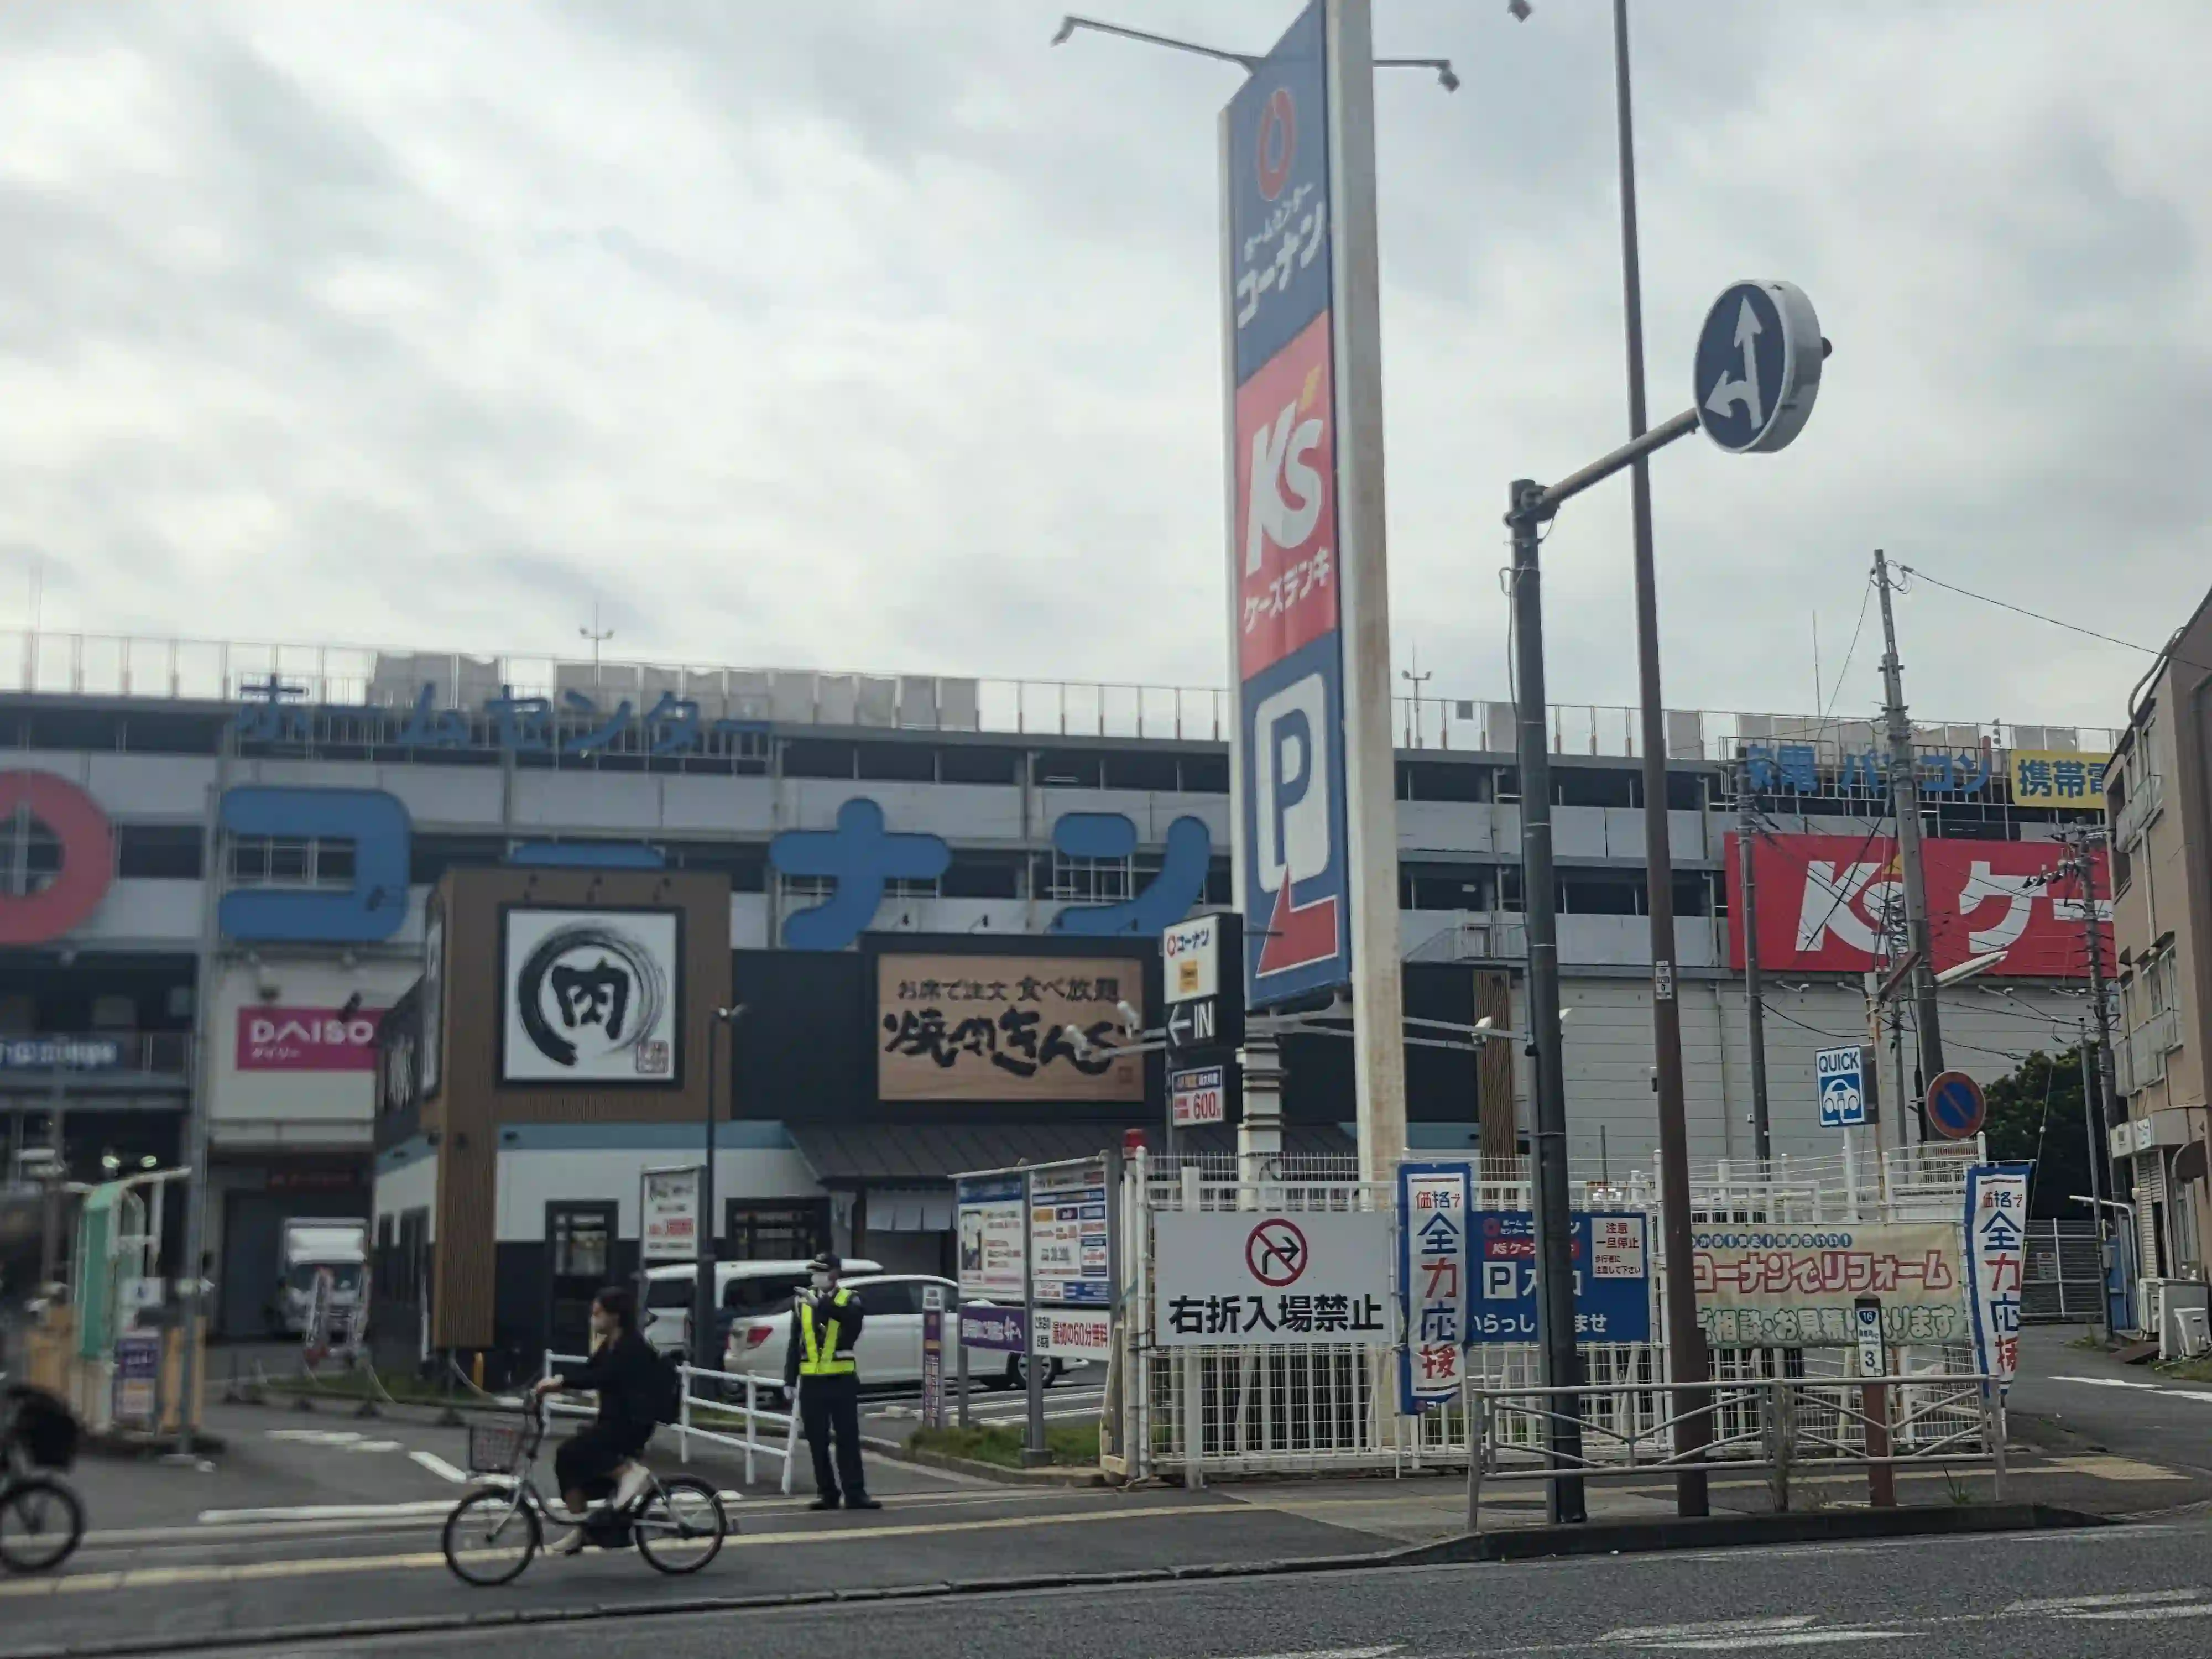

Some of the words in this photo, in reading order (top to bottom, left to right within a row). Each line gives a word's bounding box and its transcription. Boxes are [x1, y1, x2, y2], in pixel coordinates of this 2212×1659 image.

[1237, 201, 1324, 329] コーナン
[1840, 735, 1991, 792] パコン
[1176, 928, 1209, 952] コーナン
[1194, 1000, 1215, 1039] IN
[250, 1019, 373, 1045] DAISO
[1819, 1051, 1859, 1073] QUICK
[1605, 1222, 1628, 1234] 注意
[1595, 1237, 1640, 1249] 一旦停止
[1693, 1249, 1952, 1294] コーナンでリフォーム
[1168, 1293, 1384, 1334] 右折入場禁止
[1474, 1313, 1608, 1333] らっしませ
[1863, 1312, 1873, 1322] 16
[1865, 1350, 1875, 1368] 3
